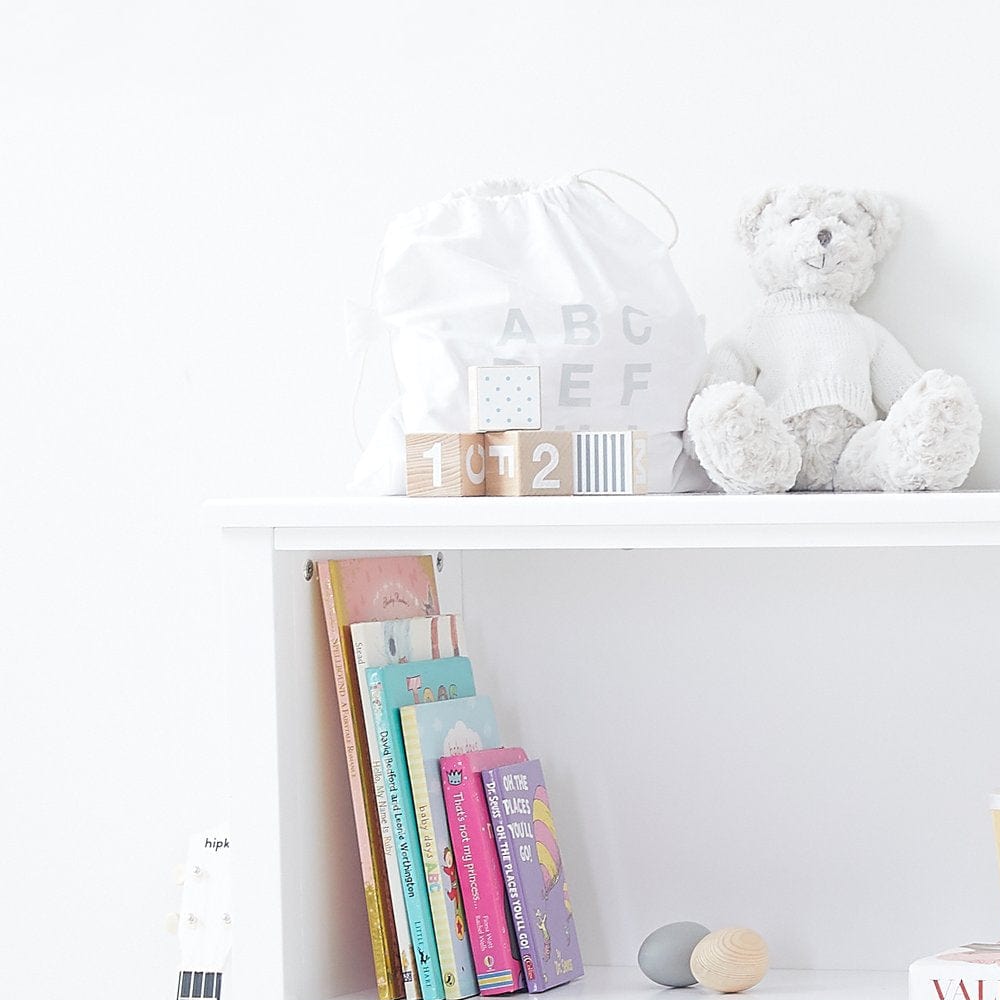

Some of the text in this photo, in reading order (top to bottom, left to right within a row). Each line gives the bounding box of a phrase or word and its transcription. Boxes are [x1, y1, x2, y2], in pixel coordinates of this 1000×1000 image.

[496, 304, 652, 346] A B C
[558, 363, 652, 407] E F
[422, 442, 443, 488] 1
[532, 443, 560, 489] 2
[380, 731, 391, 756] David
[400, 842, 416, 898] Worthington
[419, 805, 429, 831] baby
[453, 792, 467, 822] That's
[502, 798, 531, 815] PLACES
[423, 836, 433, 859] days
[459, 824, 471, 843] not
[461, 845, 473, 862] my
[500, 842, 511, 861] THE
[504, 863, 519, 899] PLACES
